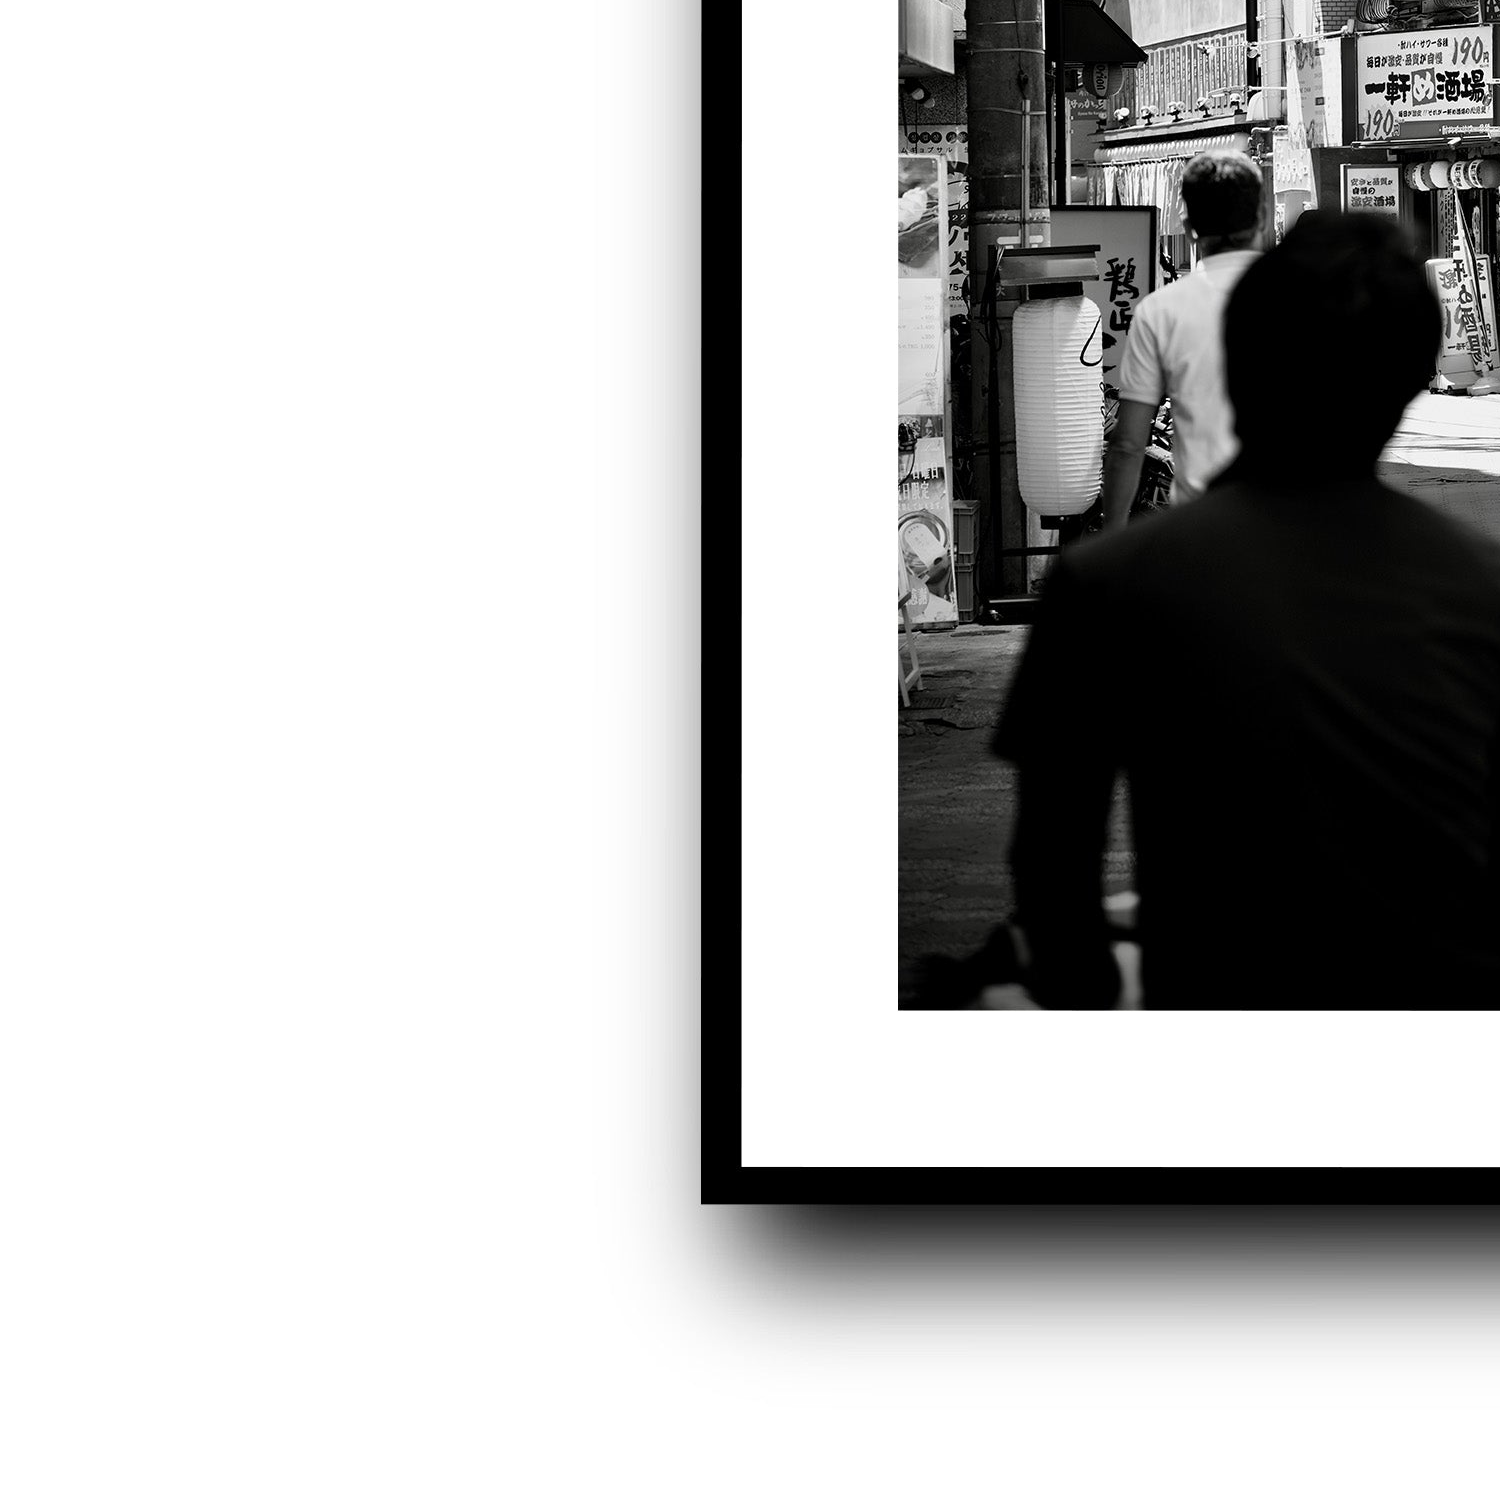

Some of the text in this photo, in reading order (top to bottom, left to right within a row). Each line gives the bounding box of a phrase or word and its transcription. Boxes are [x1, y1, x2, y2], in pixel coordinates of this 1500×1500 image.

[1364, 67, 1486, 107] 一軒め酒場
